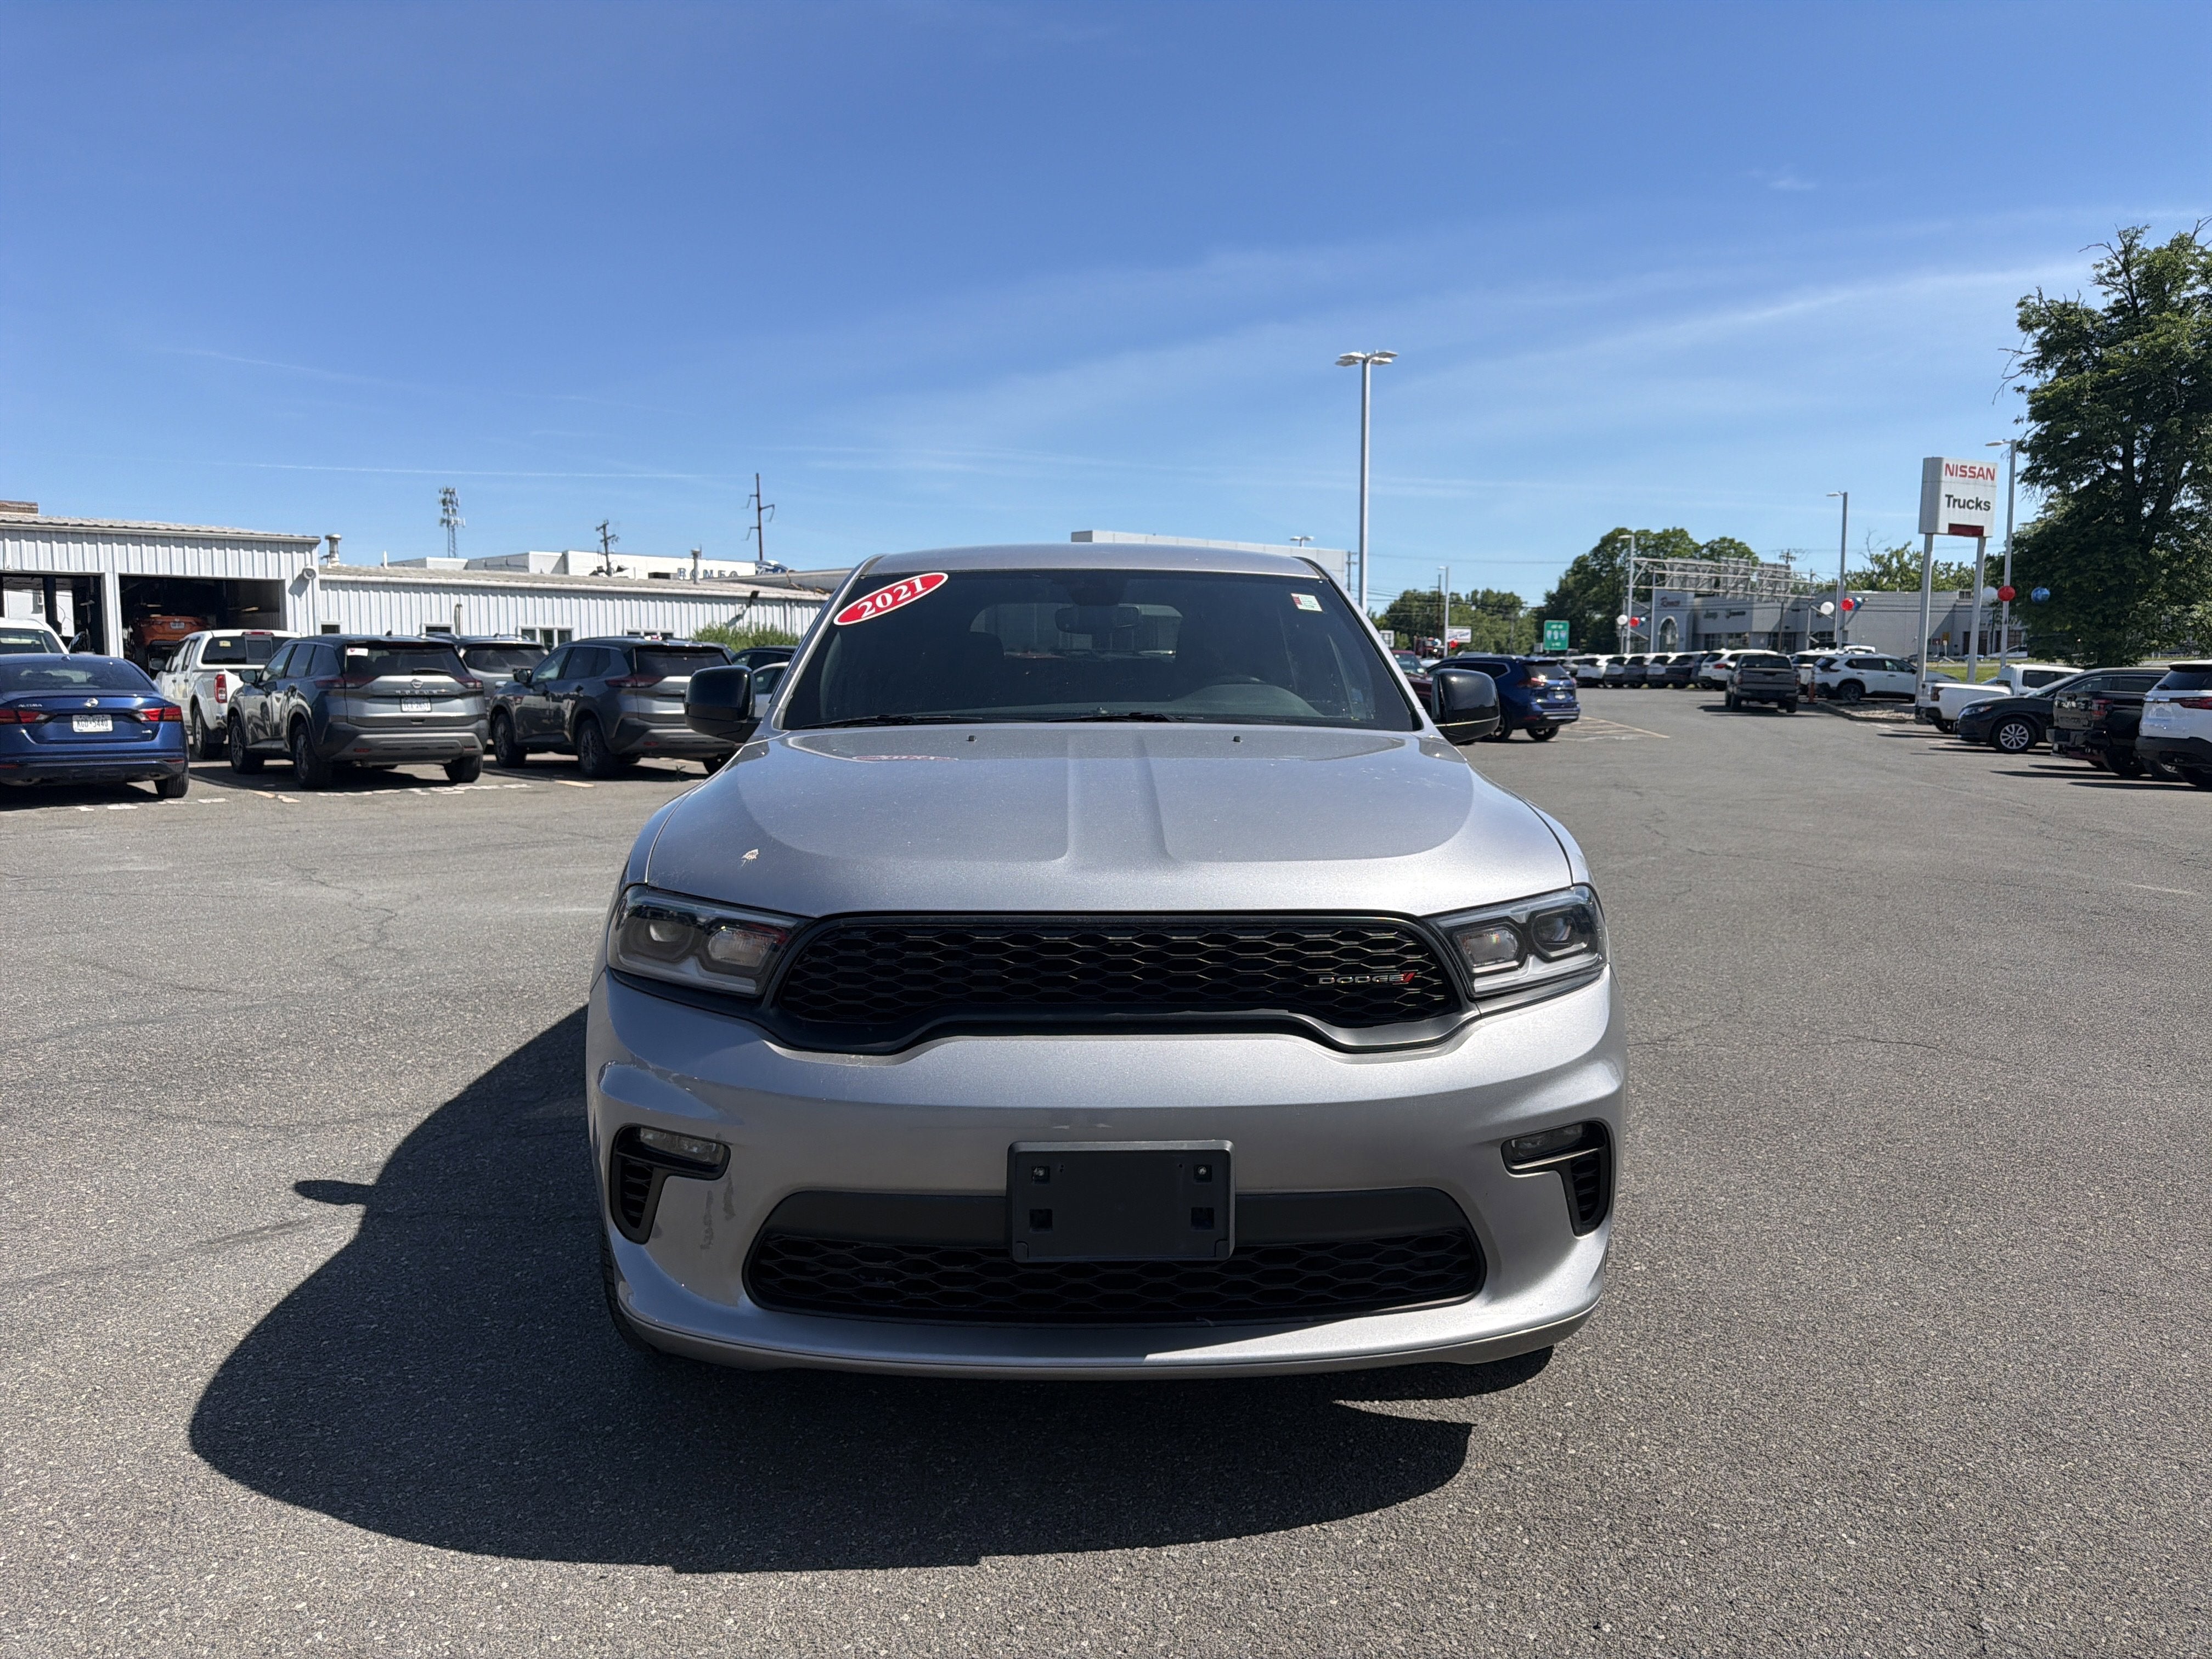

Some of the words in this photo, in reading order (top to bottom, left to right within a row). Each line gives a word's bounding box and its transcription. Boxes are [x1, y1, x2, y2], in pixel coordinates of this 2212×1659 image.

[1944, 462, 1996, 481] NISSAN
[1944, 494, 1991, 511] Trucks
[857, 577, 928, 618] 2021
[1318, 974, 1404, 984] DODGE
